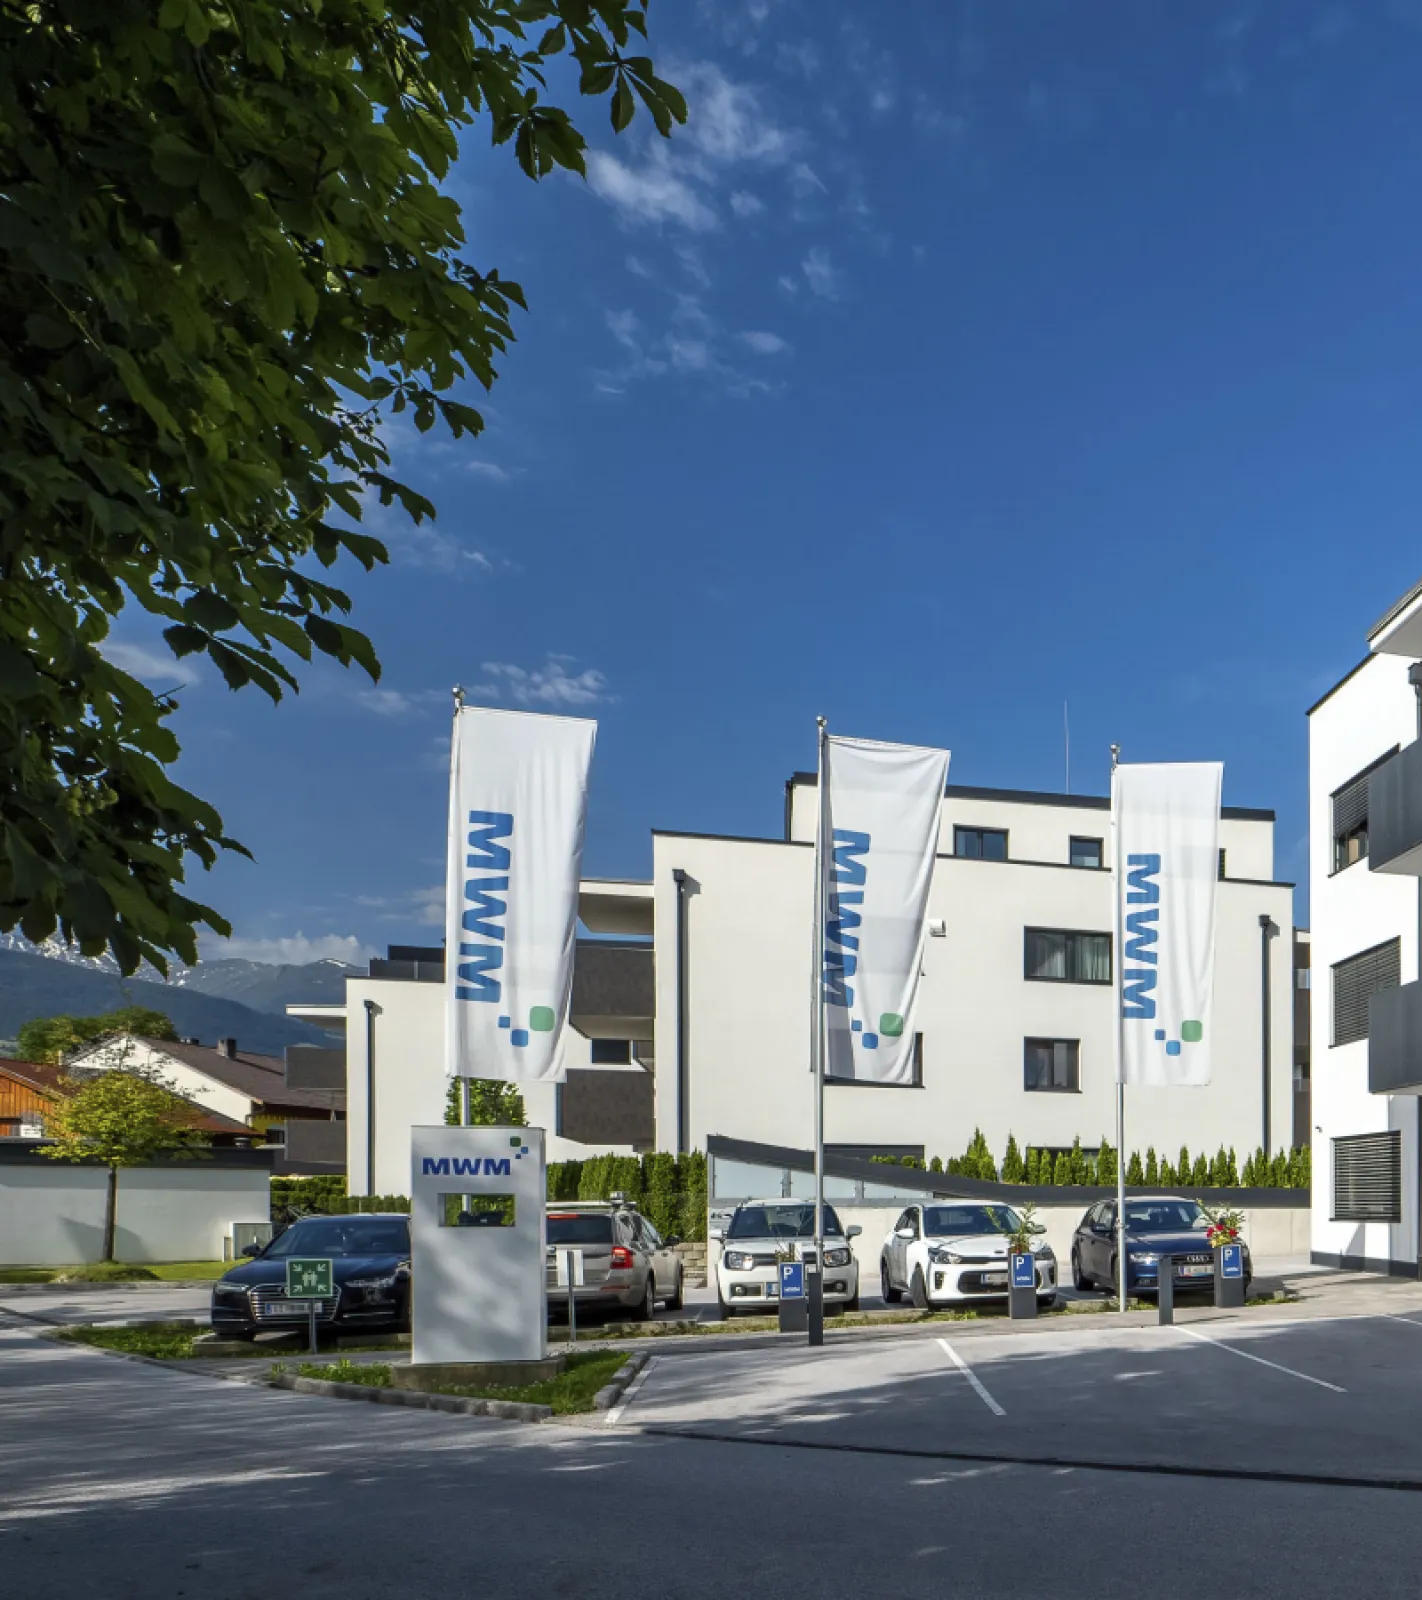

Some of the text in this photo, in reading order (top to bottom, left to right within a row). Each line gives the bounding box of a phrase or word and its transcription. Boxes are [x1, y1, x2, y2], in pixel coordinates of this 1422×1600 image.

[456, 810, 514, 1003] MWM
[823, 828, 871, 1008] MWM
[1123, 853, 1162, 1019] MWM
[422, 1157, 511, 1176] MWM
[1016, 1256, 1025, 1270] P
[1224, 1248, 1233, 1261] P
[783, 1266, 794, 1280] P
